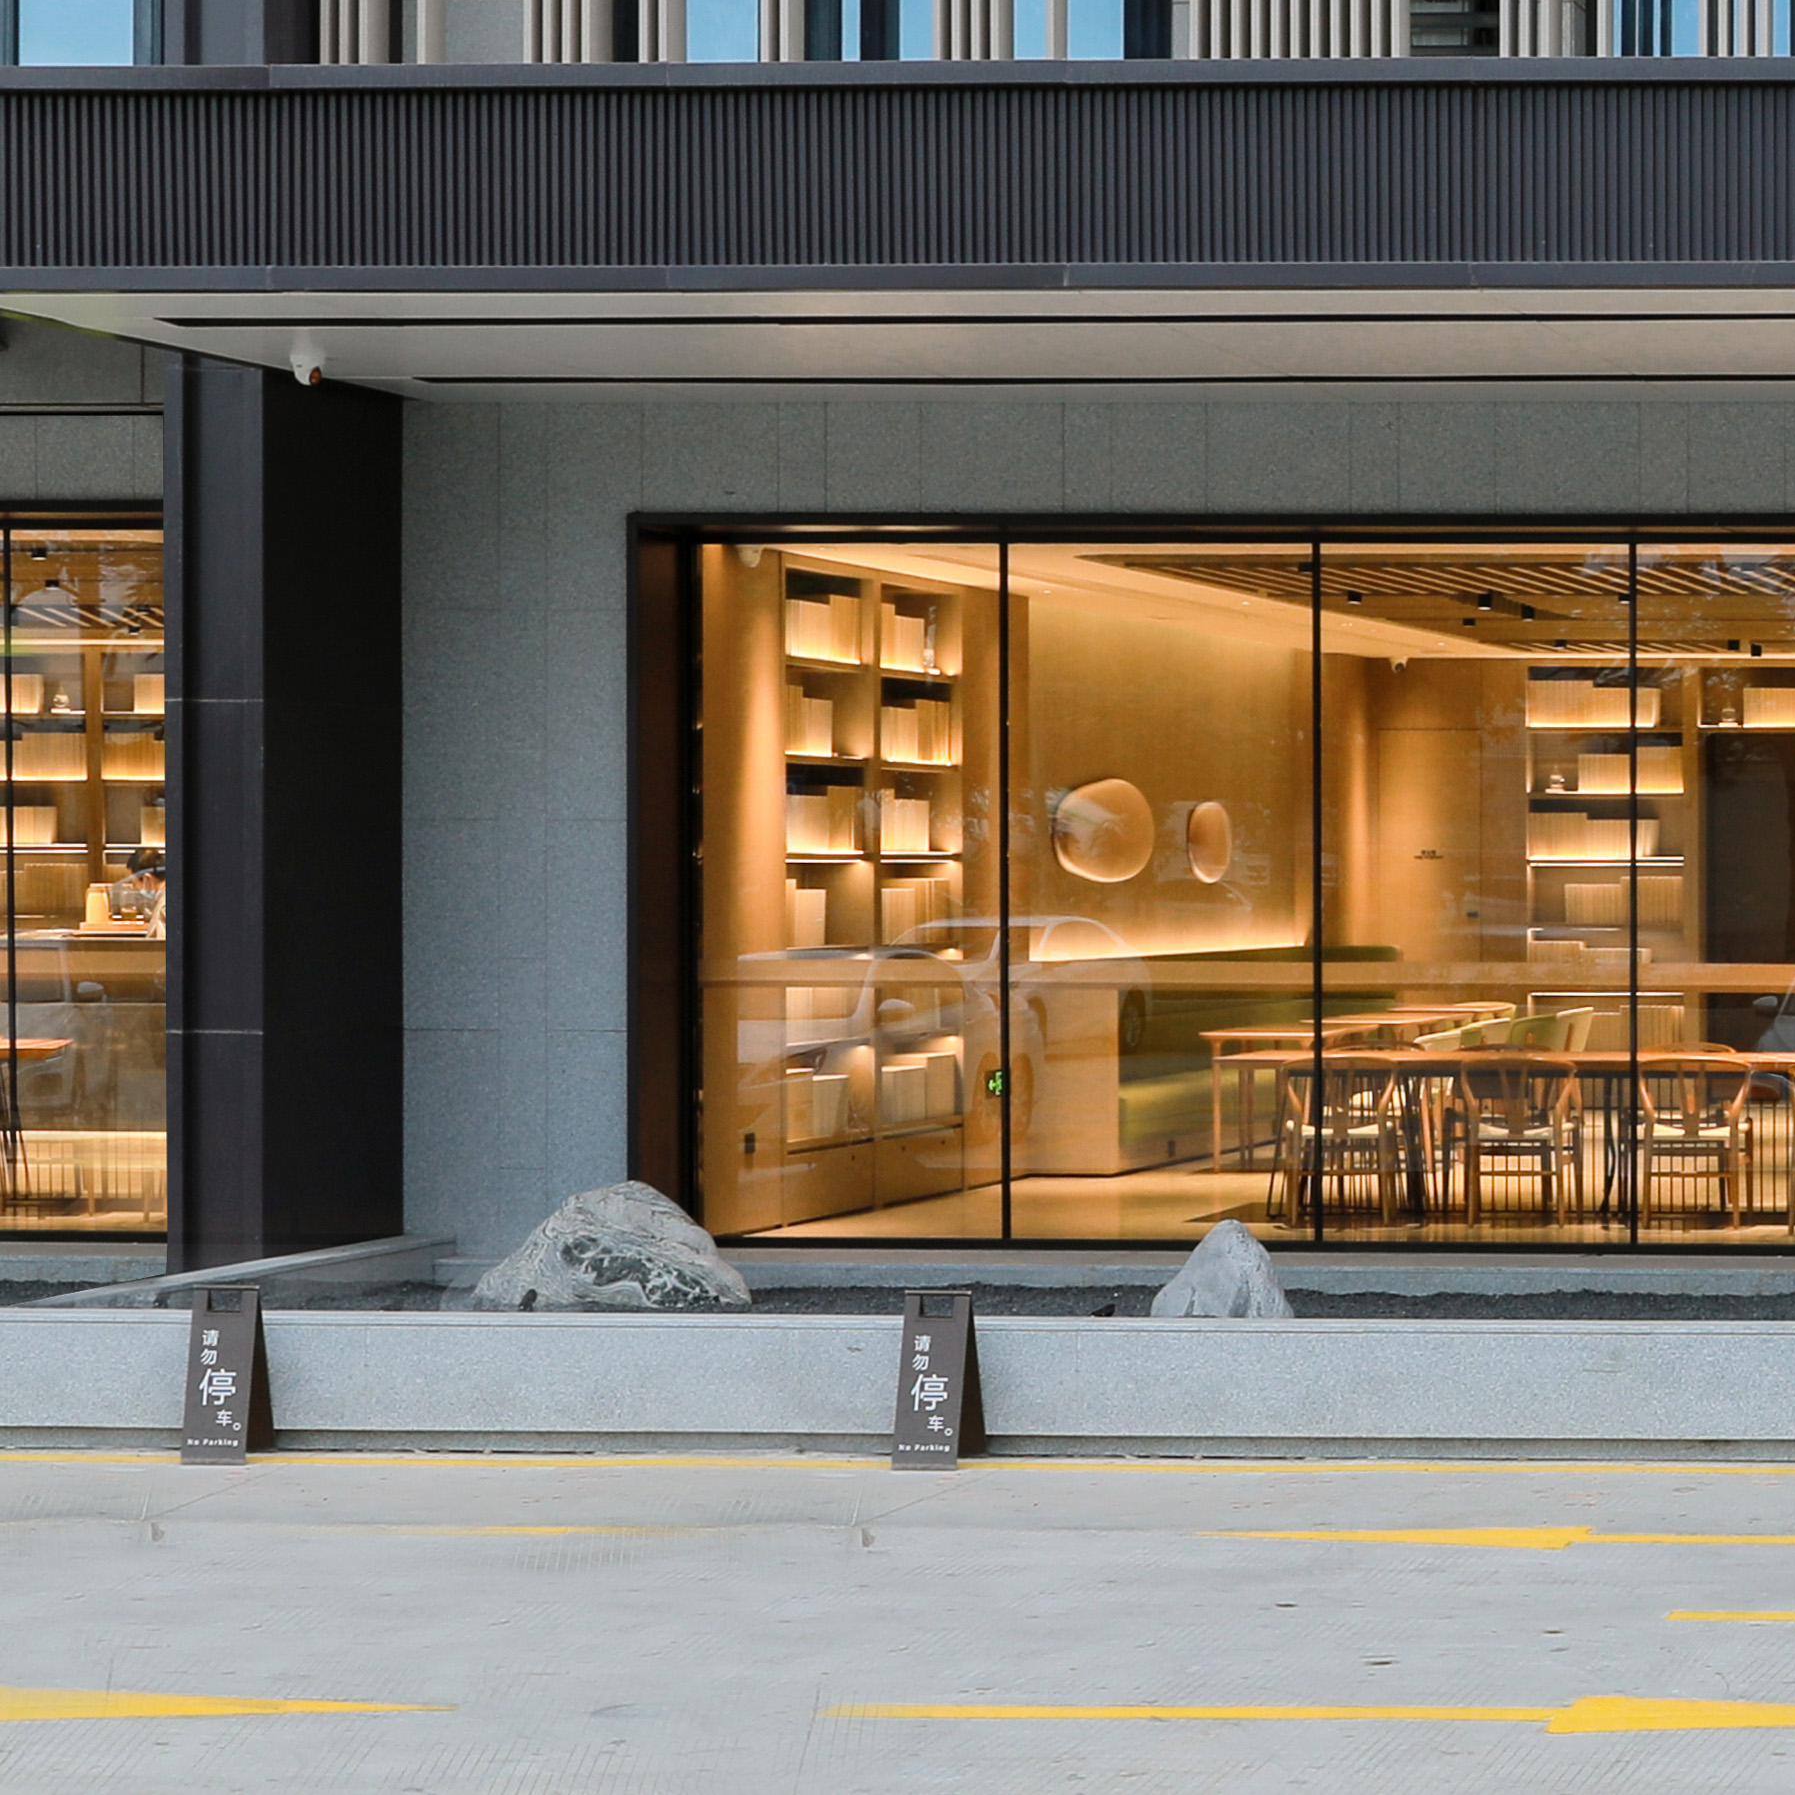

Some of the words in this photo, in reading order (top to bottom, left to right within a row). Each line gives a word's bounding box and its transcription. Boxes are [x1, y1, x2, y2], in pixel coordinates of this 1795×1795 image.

[186, 1438, 199, 1446] No
[202, 1438, 239, 1447] Parking
[898, 1443, 911, 1452] No
[914, 1443, 950, 1453] Parking
